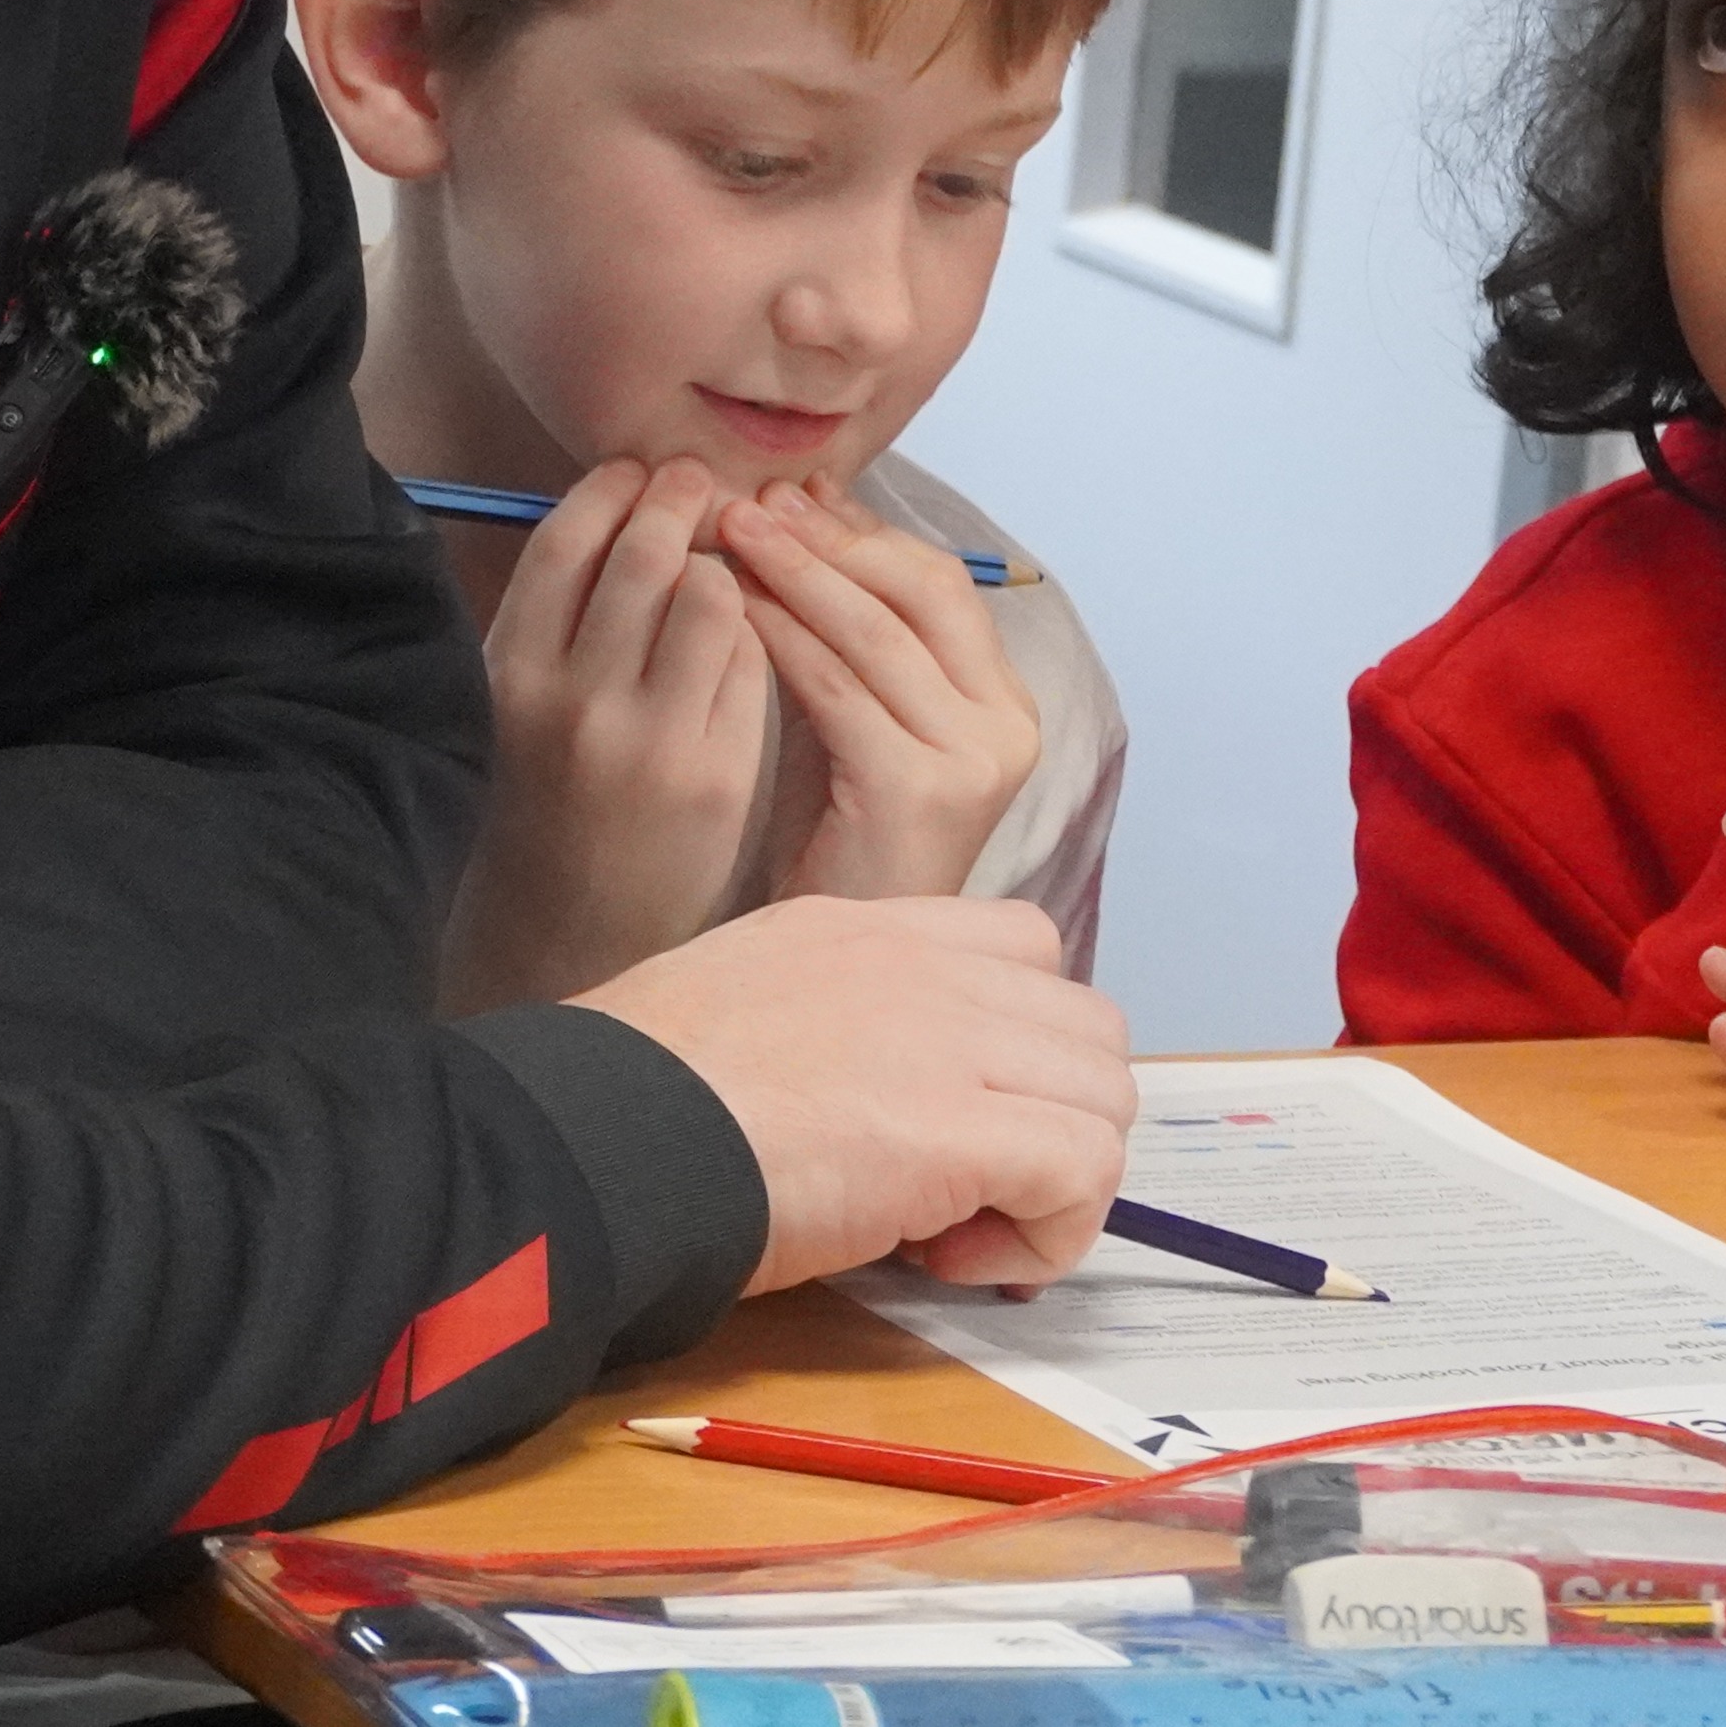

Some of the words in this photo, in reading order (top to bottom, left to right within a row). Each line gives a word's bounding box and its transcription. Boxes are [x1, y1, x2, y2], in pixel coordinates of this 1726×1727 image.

[1477, 1361, 1555, 1373] Zone
[1553, 1356, 1672, 1371] Combat
[1295, 1376, 1370, 1388] level
[1365, 1368, 1479, 1382] looking
[1320, 1594, 1528, 1643] smartbuy
